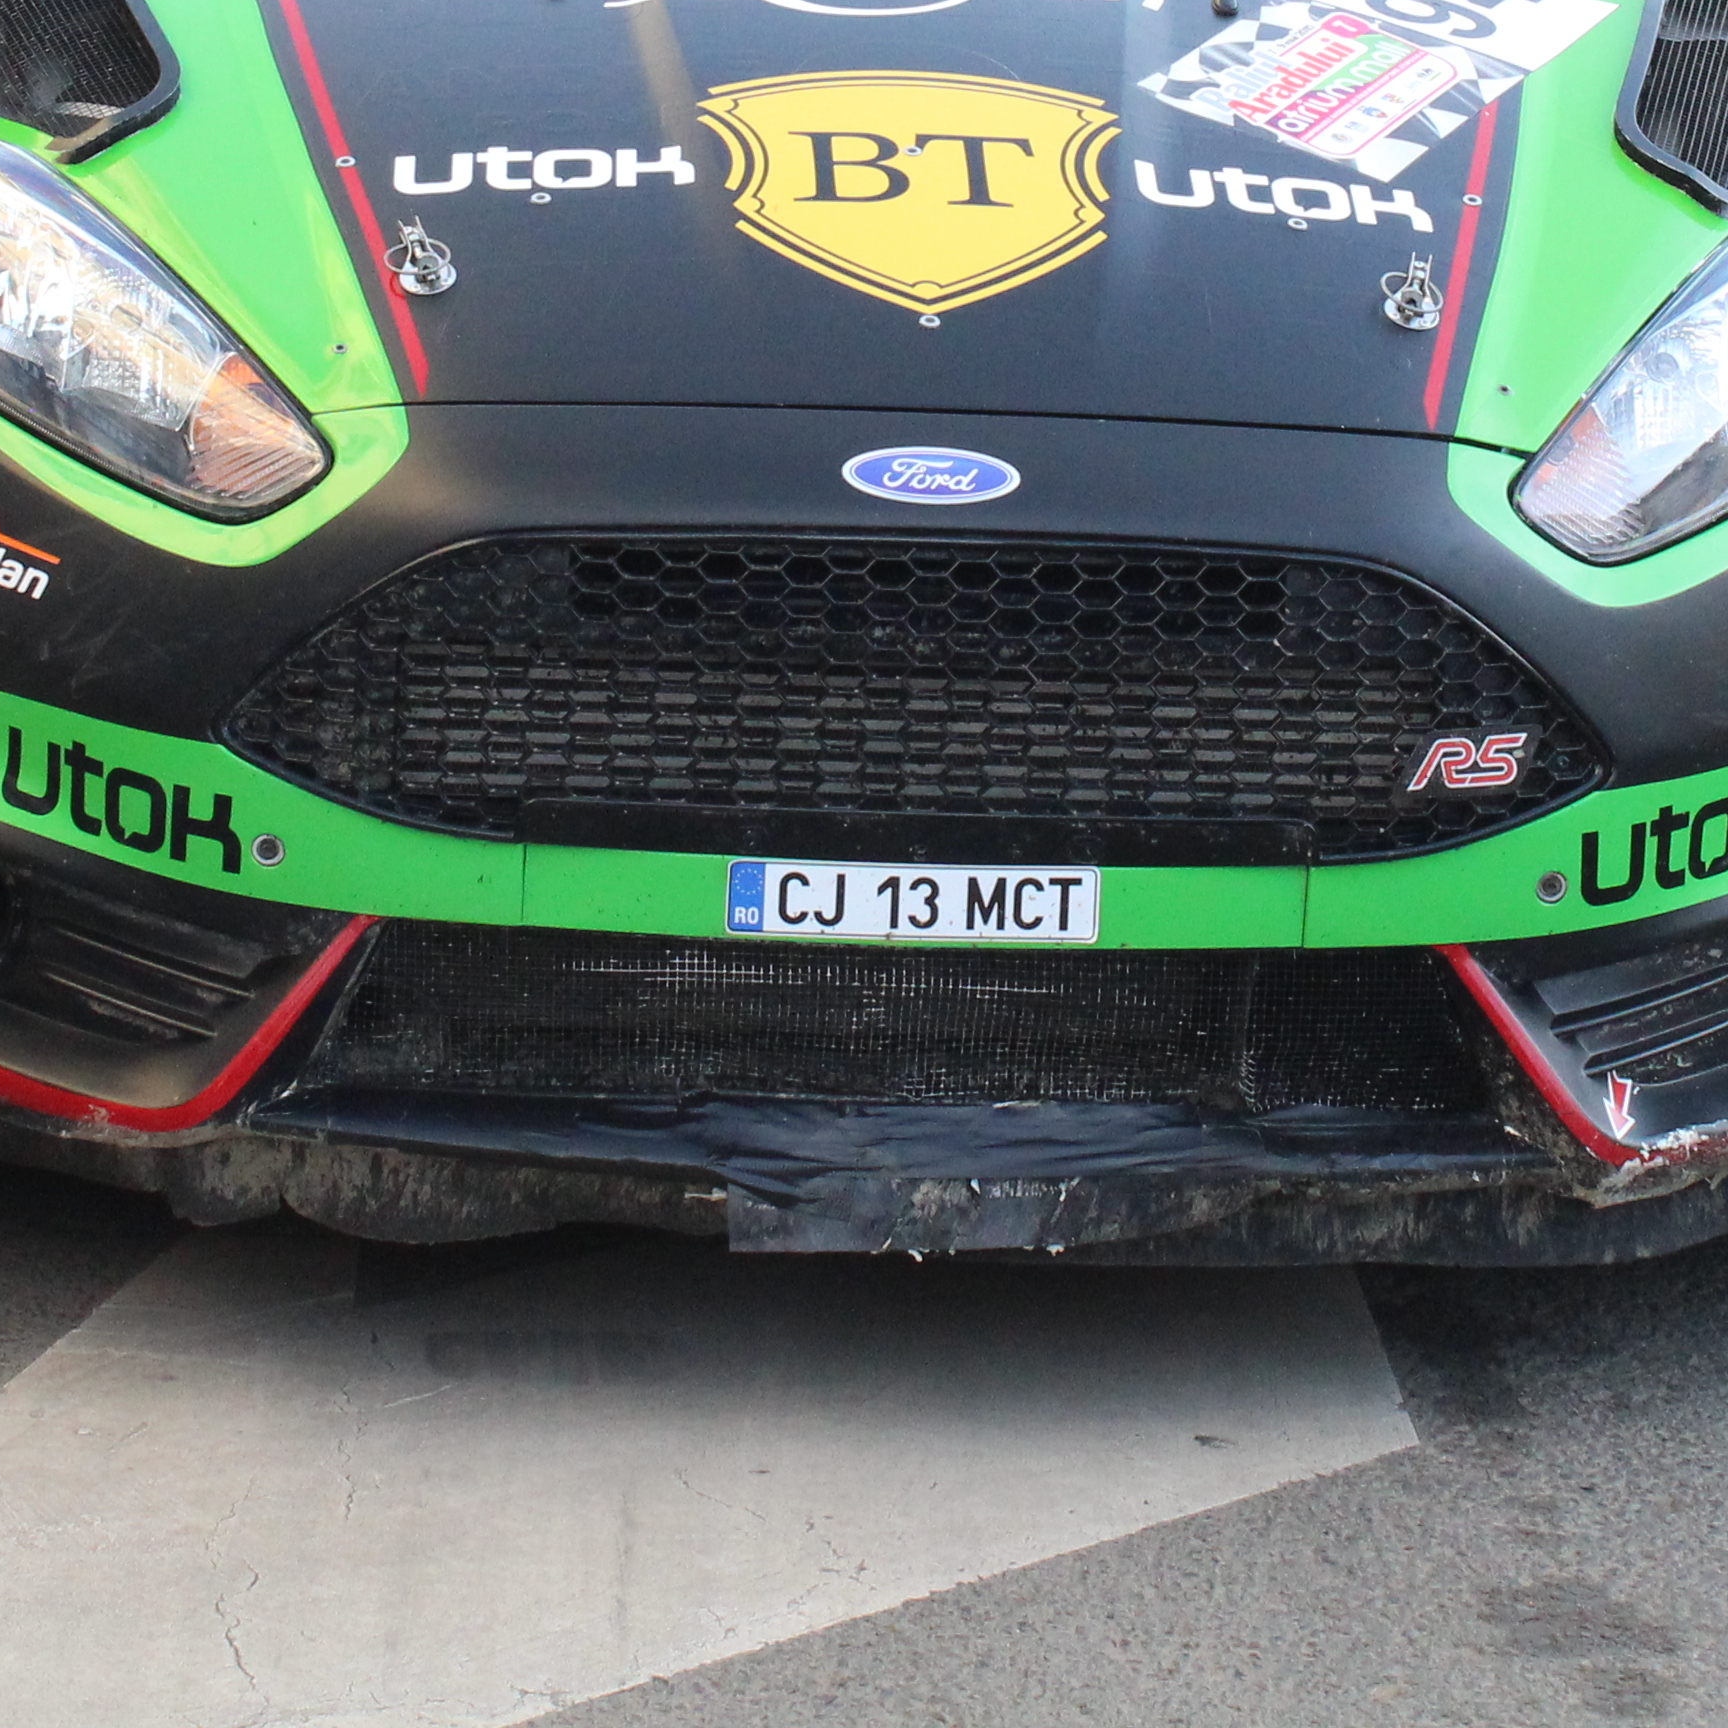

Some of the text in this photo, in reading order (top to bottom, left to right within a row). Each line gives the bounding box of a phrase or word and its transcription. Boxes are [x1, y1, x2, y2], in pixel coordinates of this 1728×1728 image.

[1196, 49, 1295, 114] Raliul
[1228, 37, 1356, 122] Aradului
[1276, 78, 1360, 134] atrium
[1349, 41, 1412, 87] mall
[787, 129, 1034, 209] BT
[879, 455, 978, 493] Ford
[733, 871, 1083, 933] RO CJ 13 MCT
